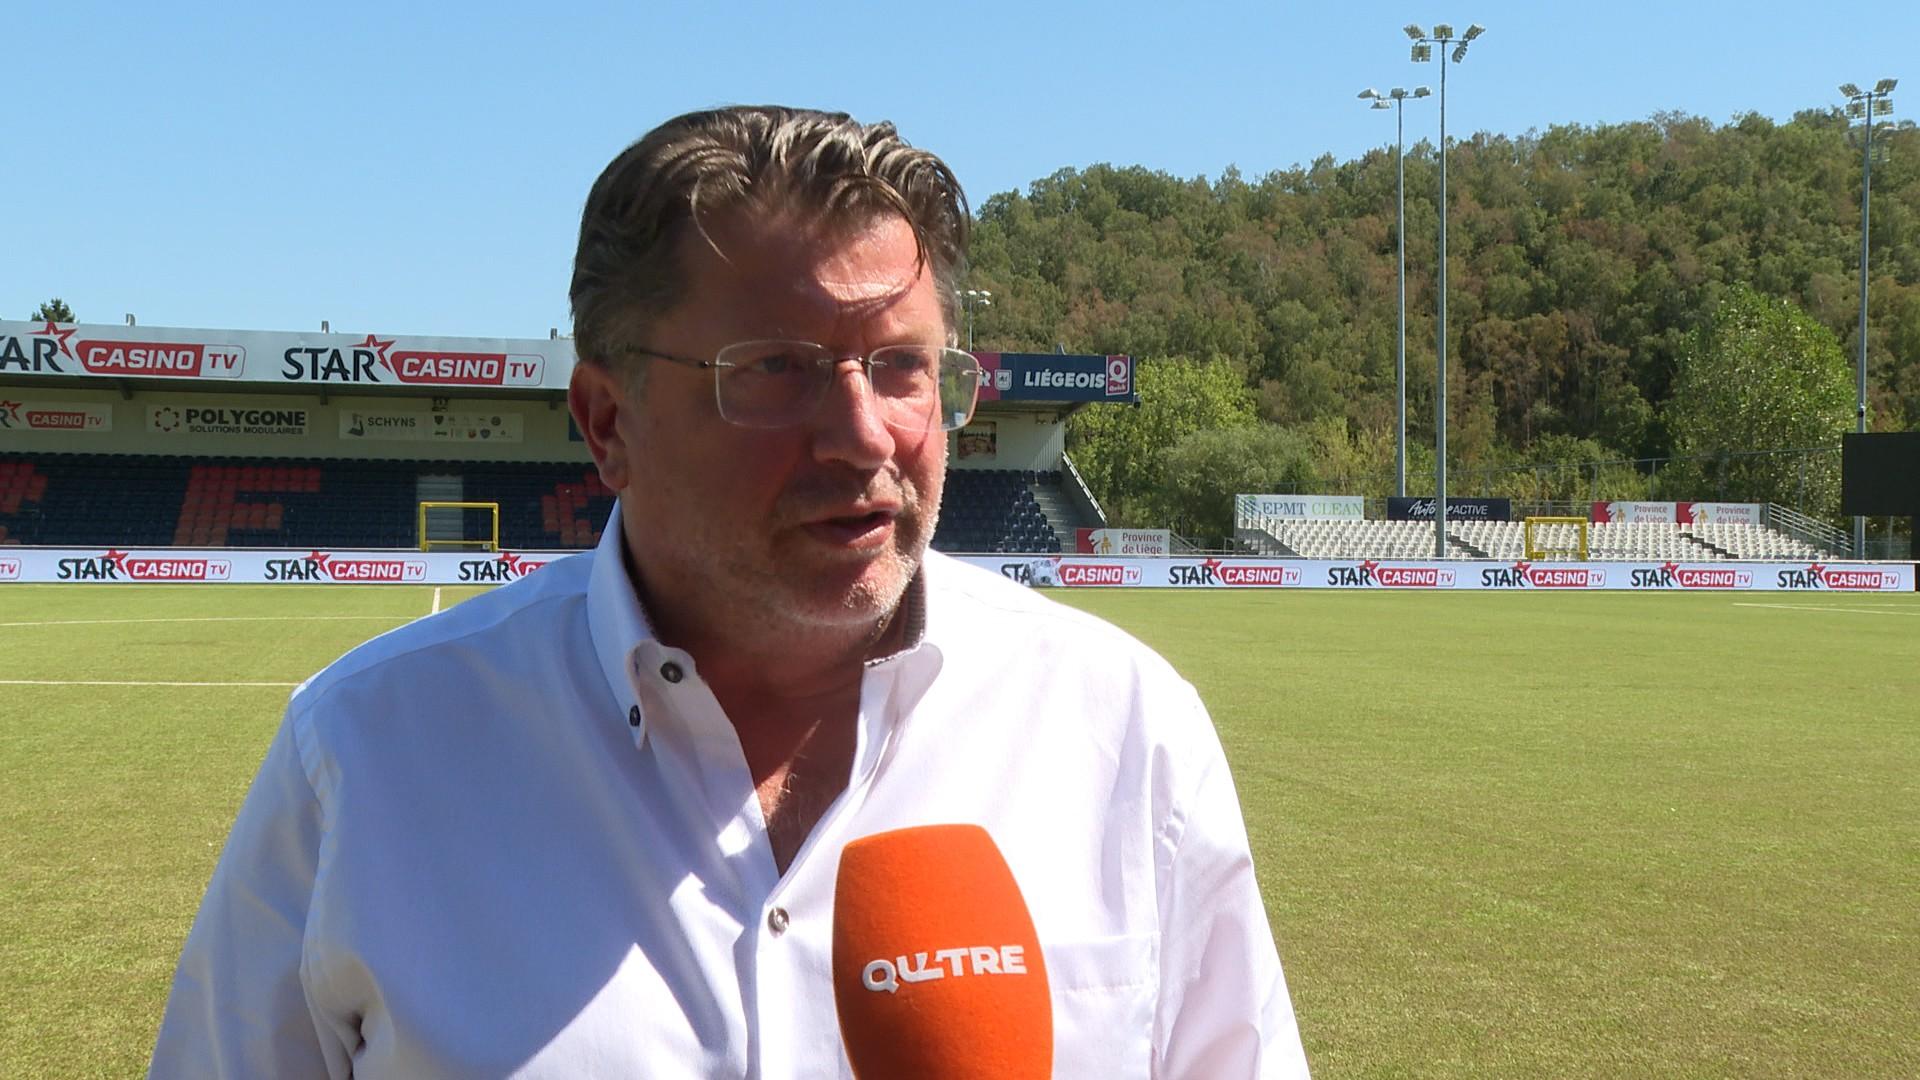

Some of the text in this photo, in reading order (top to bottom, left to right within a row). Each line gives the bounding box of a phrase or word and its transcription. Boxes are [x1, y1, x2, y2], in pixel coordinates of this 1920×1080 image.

[0, 336, 238, 373] AR CASINO TV
[281, 347, 537, 382] STAR CASINO TV
[1024, 368, 1106, 388] LIÉGEOIS
[32, 414, 102, 425] CASINO TV
[186, 408, 305, 426] POLYGONE
[367, 417, 416, 427] SCHYNS
[189, 425, 304, 435] SOLUTIONS MODULAIRES
[1262, 502, 1362, 515] EPMT CLEAN
[1634, 504, 1668, 514] Province
[1716, 506, 1750, 515] Province
[1122, 532, 1163, 543] Province
[1122, 544, 1134, 554] de
[57, 558, 227, 580] STAR CASINO TV
[264, 559, 423, 581] STAR CASINO TV
[458, 560, 512, 581] STAR
[1065, 568, 1121, 582] CASINO
[1126, 571, 1139, 580] TV
[1168, 566, 1298, 585] STAR CASINO TV
[1327, 567, 1453, 586] STAR CASINO TV
[1481, 568, 1603, 587] STAR CASINO TV
[1630, 568, 1750, 587] STAR CASINO TV
[1777, 570, 1896, 588] STAR CASINO TV
